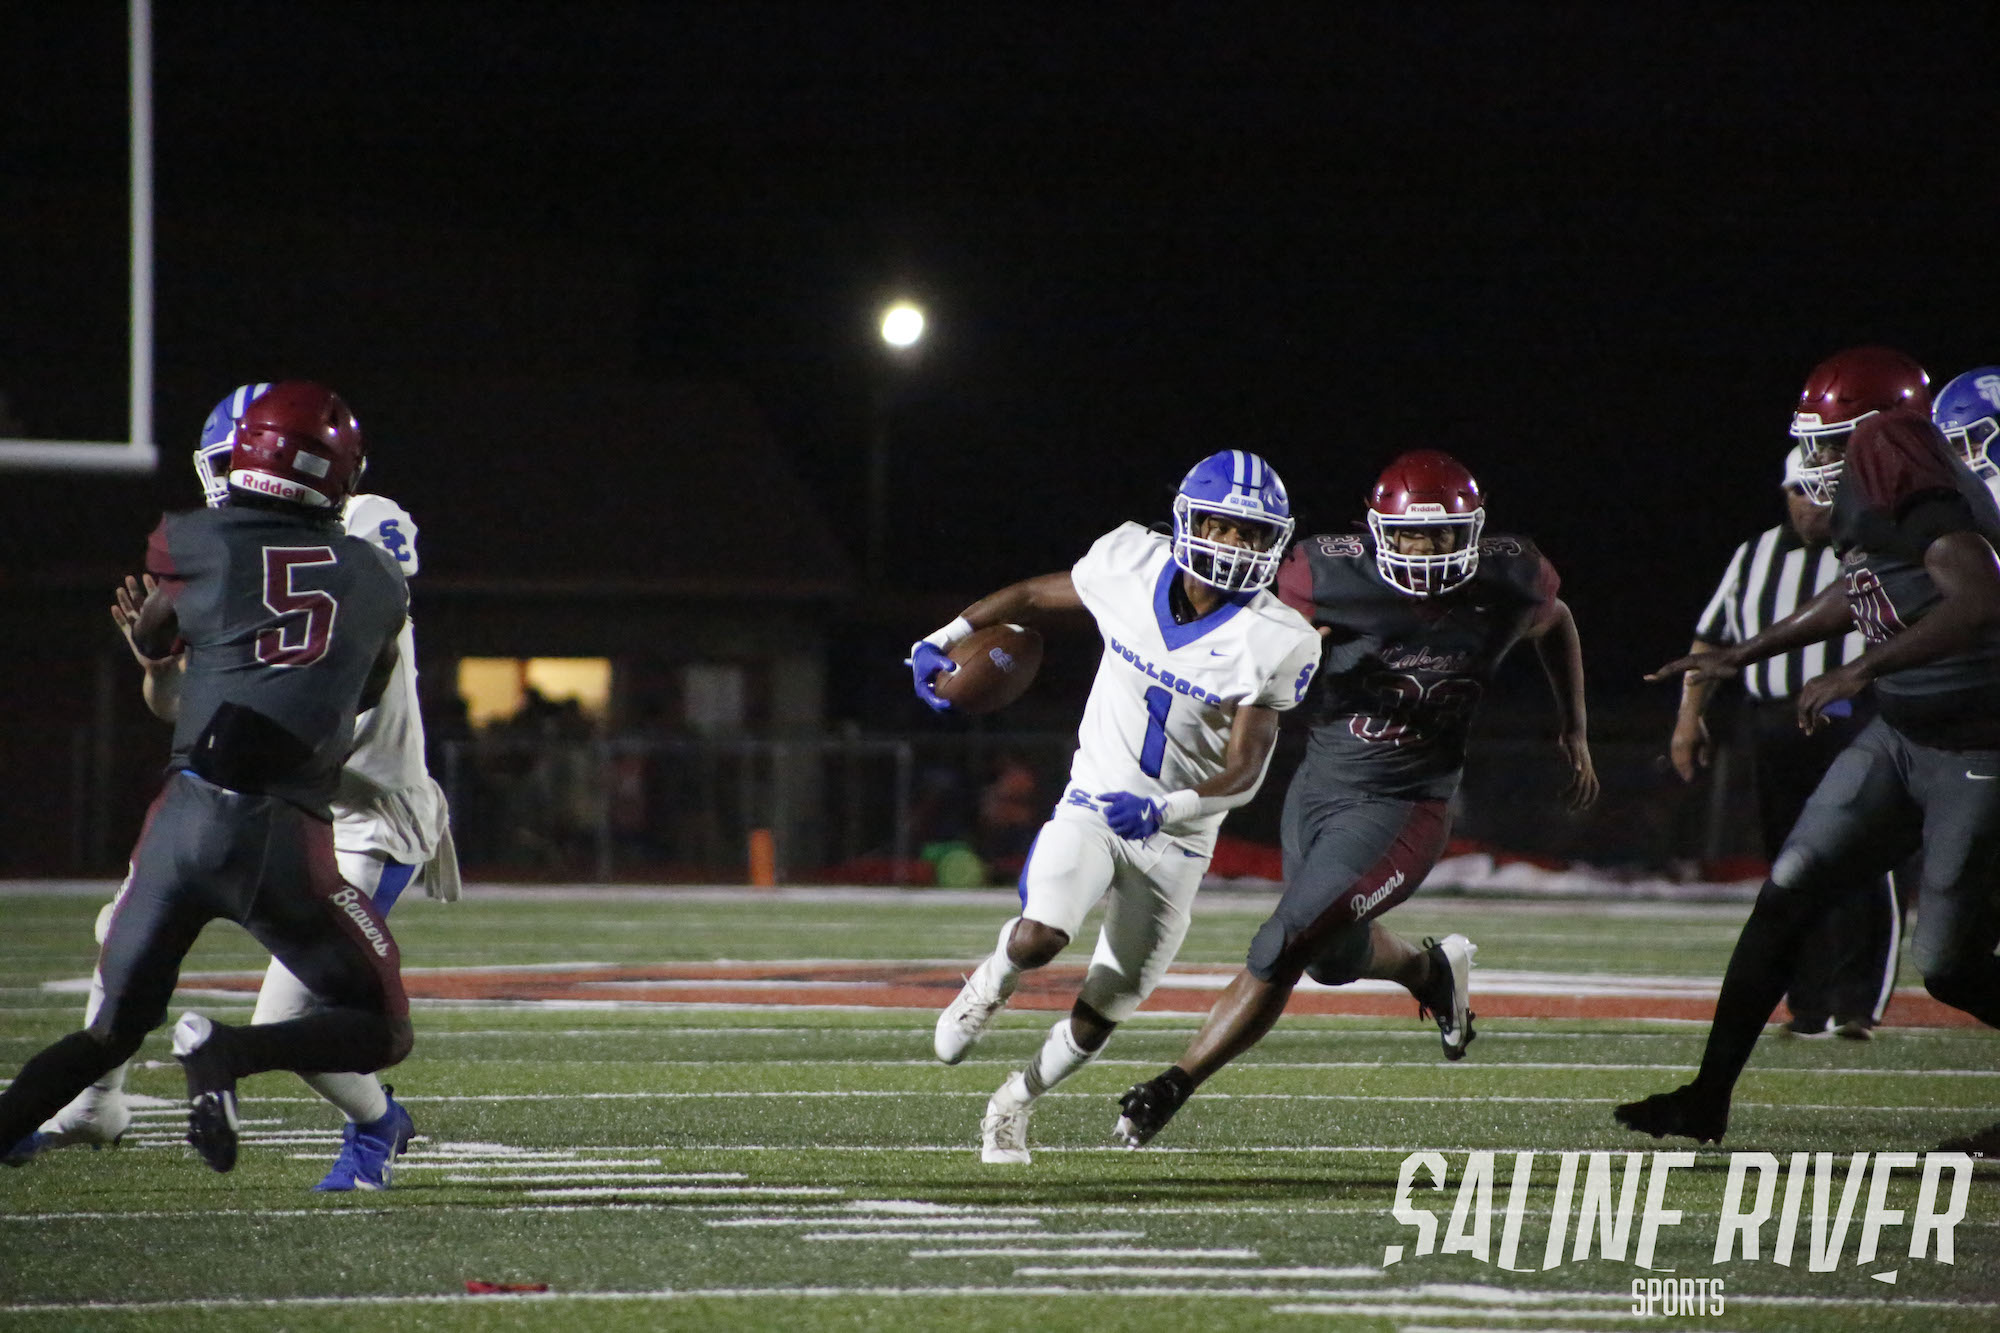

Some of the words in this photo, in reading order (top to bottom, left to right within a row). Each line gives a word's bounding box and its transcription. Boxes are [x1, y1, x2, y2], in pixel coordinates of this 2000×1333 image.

[243, 474, 305, 500] Riddell
[256, 546, 337, 667] 5
[1140, 685, 1173, 779] 1
[329, 886, 389, 957] Beavers
[1350, 869, 1404, 922] Beavers
